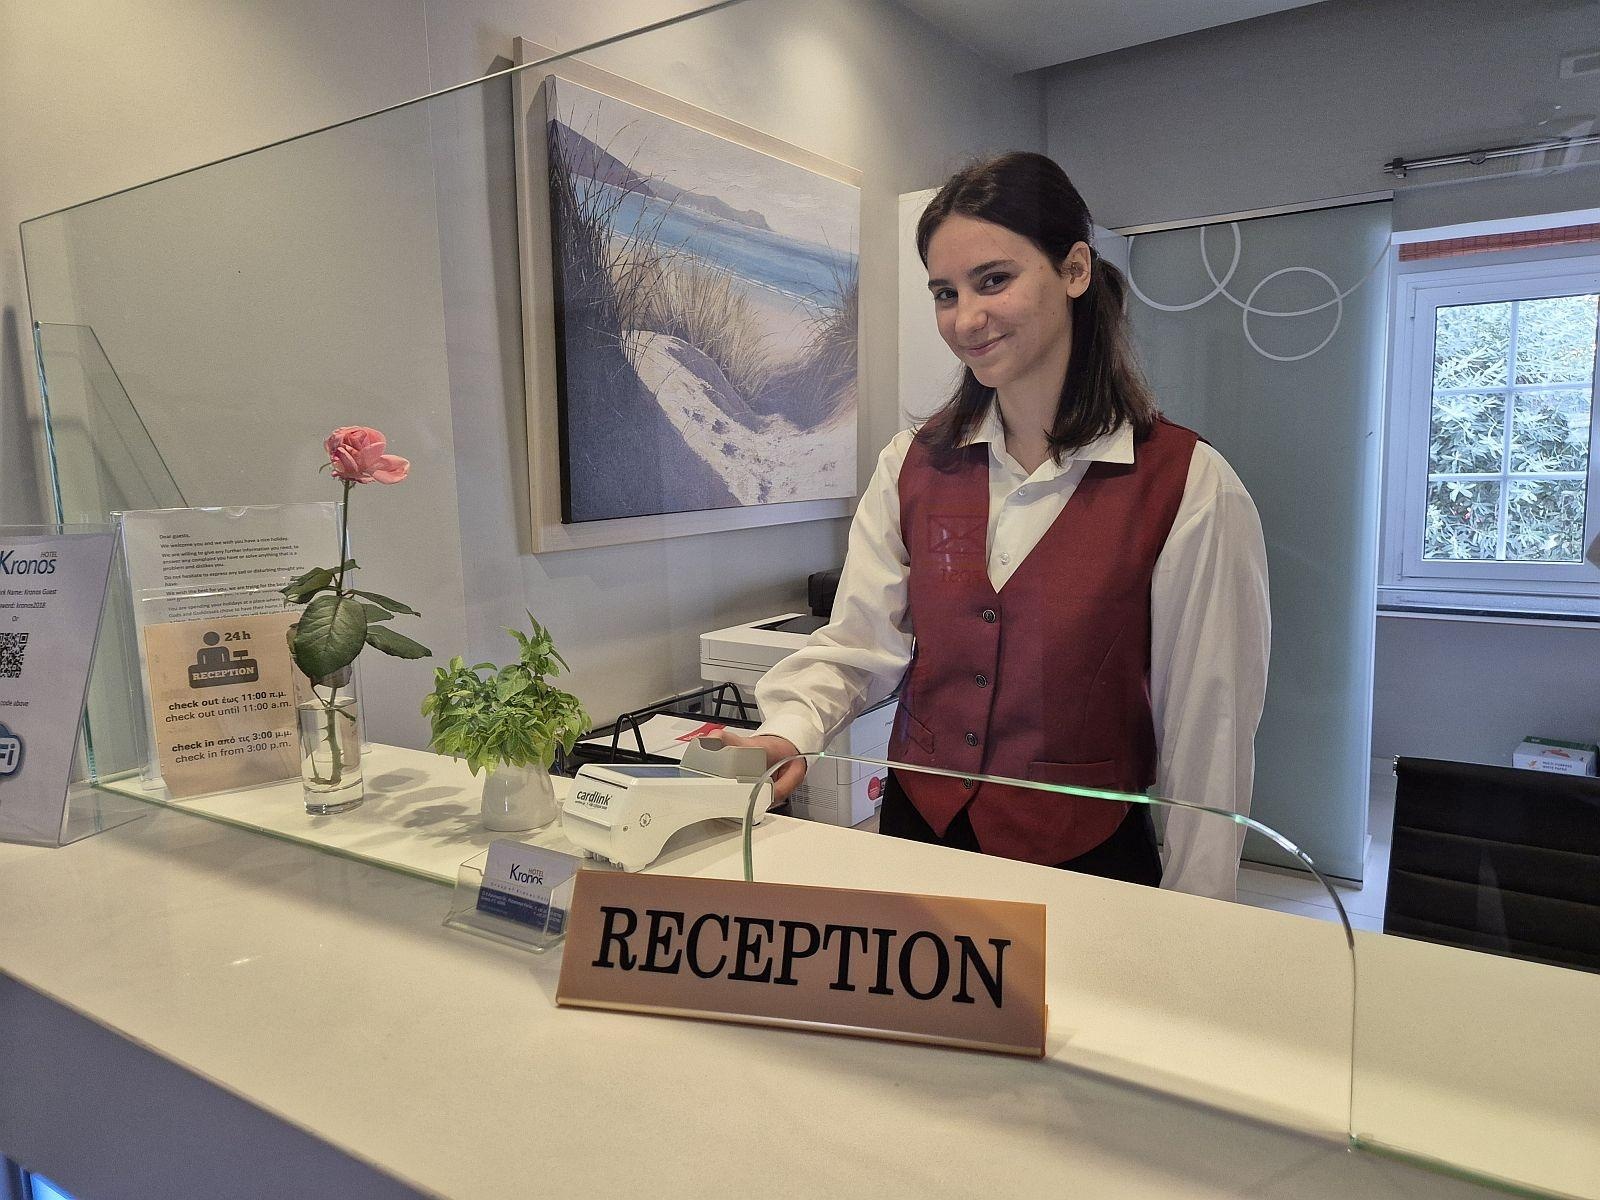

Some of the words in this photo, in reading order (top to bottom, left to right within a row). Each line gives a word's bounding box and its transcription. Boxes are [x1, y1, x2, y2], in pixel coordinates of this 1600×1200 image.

[0, 550, 57, 575] Kronos
[224, 630, 251, 642] 24h
[191, 666, 255, 681] RECEPTION
[165, 711, 195, 723] check
[198, 710, 215, 719] out
[218, 706, 240, 716] until
[243, 702, 268, 713] 11:00
[271, 700, 292, 709] a.m.
[168, 699, 199, 711] check
[201, 698, 219, 707] out
[221, 695, 239, 704] έως
[241, 691, 267, 702] 11:00
[172, 741, 202, 752] check
[205, 739, 214, 748] in
[217, 736, 236, 747] από
[238, 734, 251, 743] τις
[252, 730, 272, 741] 3:00
[175, 752, 205, 764] check
[208, 749, 217, 758] in
[220, 746, 244, 757] from
[247, 742, 267, 753] 3:00
[270, 740, 291, 751] p.m.
[576, 790, 611, 806] cardlink
[509, 863, 544, 885] Kronos
[528, 868, 544, 877] HOTEL
[591, 905, 1011, 1009] RECEPTION
